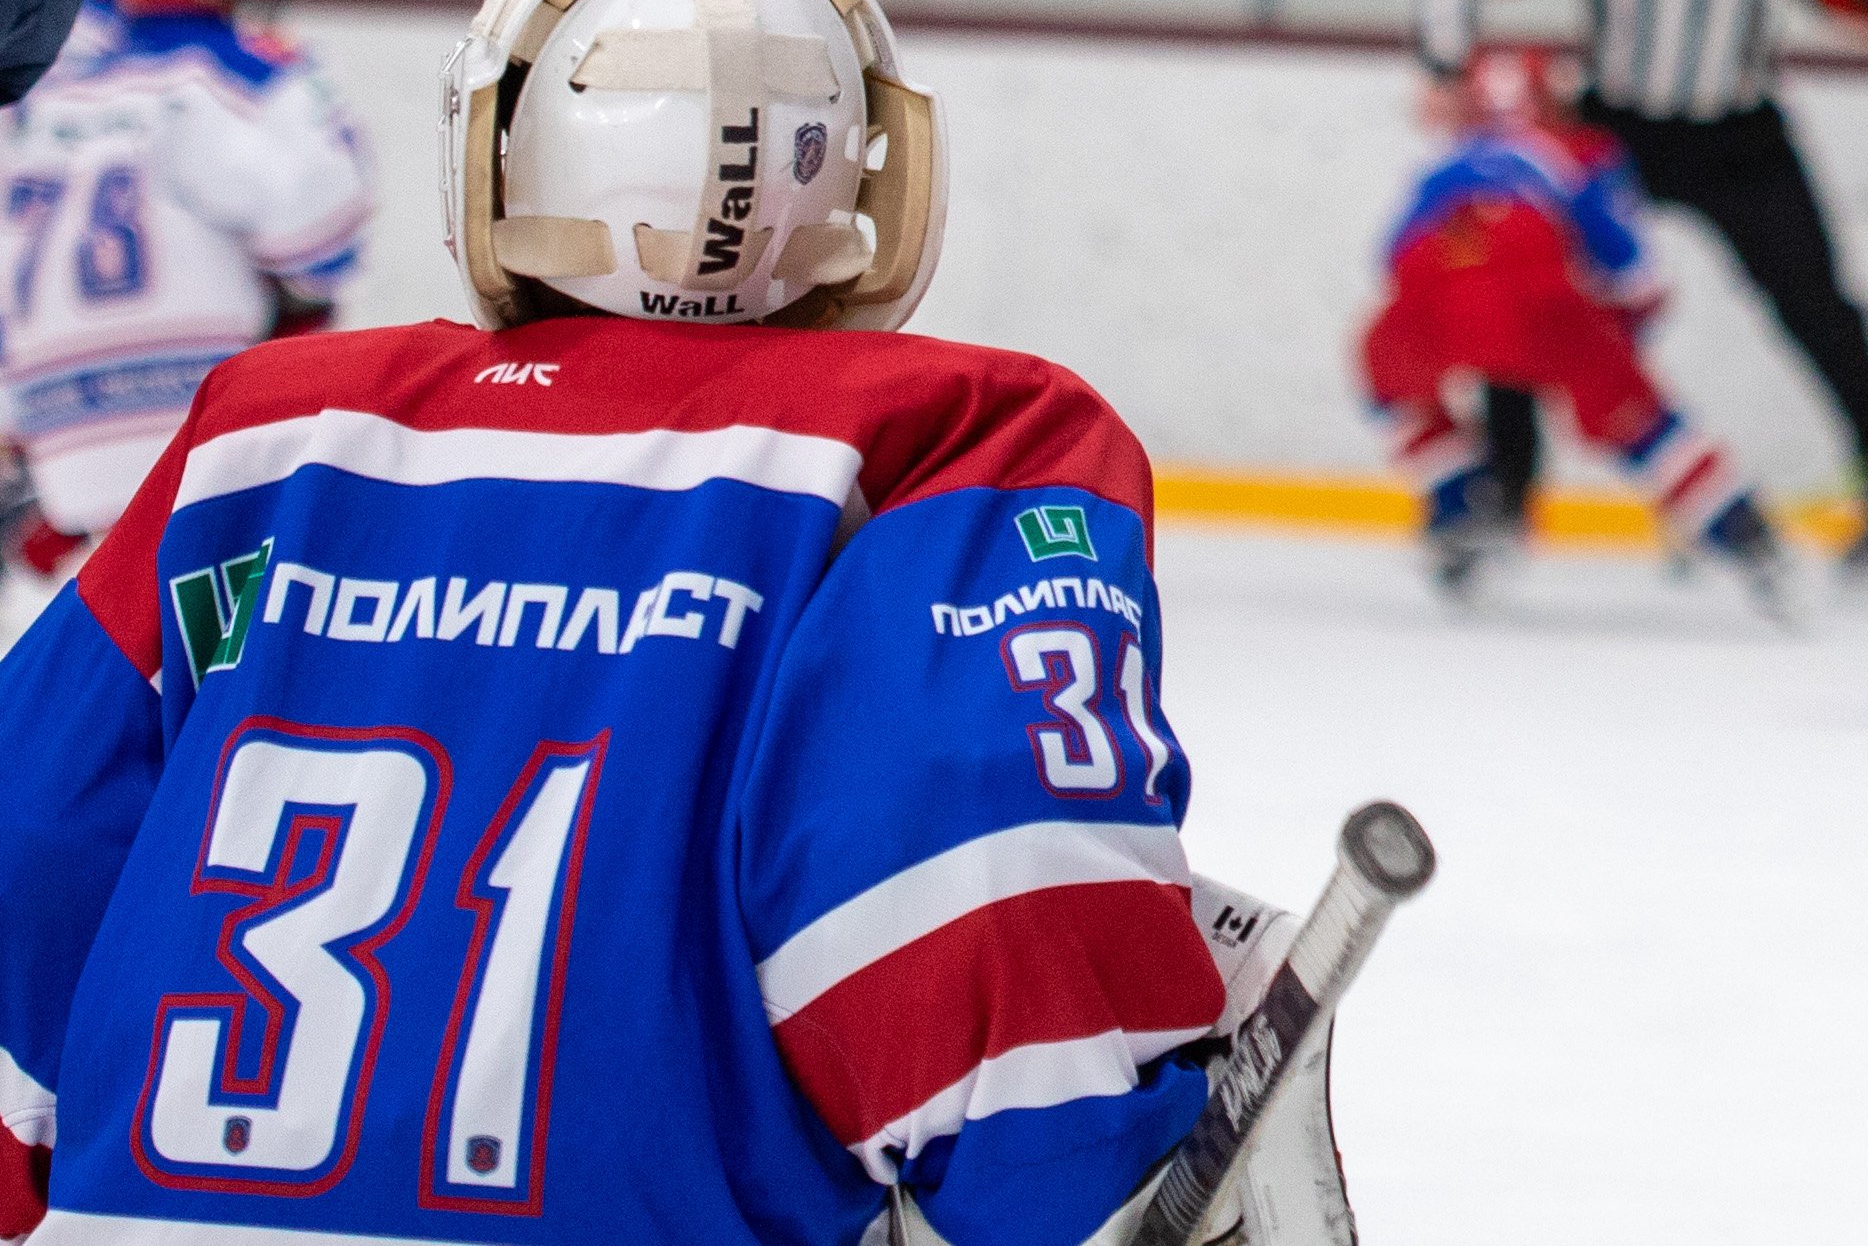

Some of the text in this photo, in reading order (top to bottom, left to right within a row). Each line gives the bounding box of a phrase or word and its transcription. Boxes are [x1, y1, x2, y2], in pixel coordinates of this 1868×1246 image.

[697, 107, 759, 275] WaLL
[640, 290, 745, 316] WaLL
[931, 577, 1143, 642] ПОЛИПЛАС
[1003, 622, 1172, 803] 31
[135, 717, 610, 1214] 31
